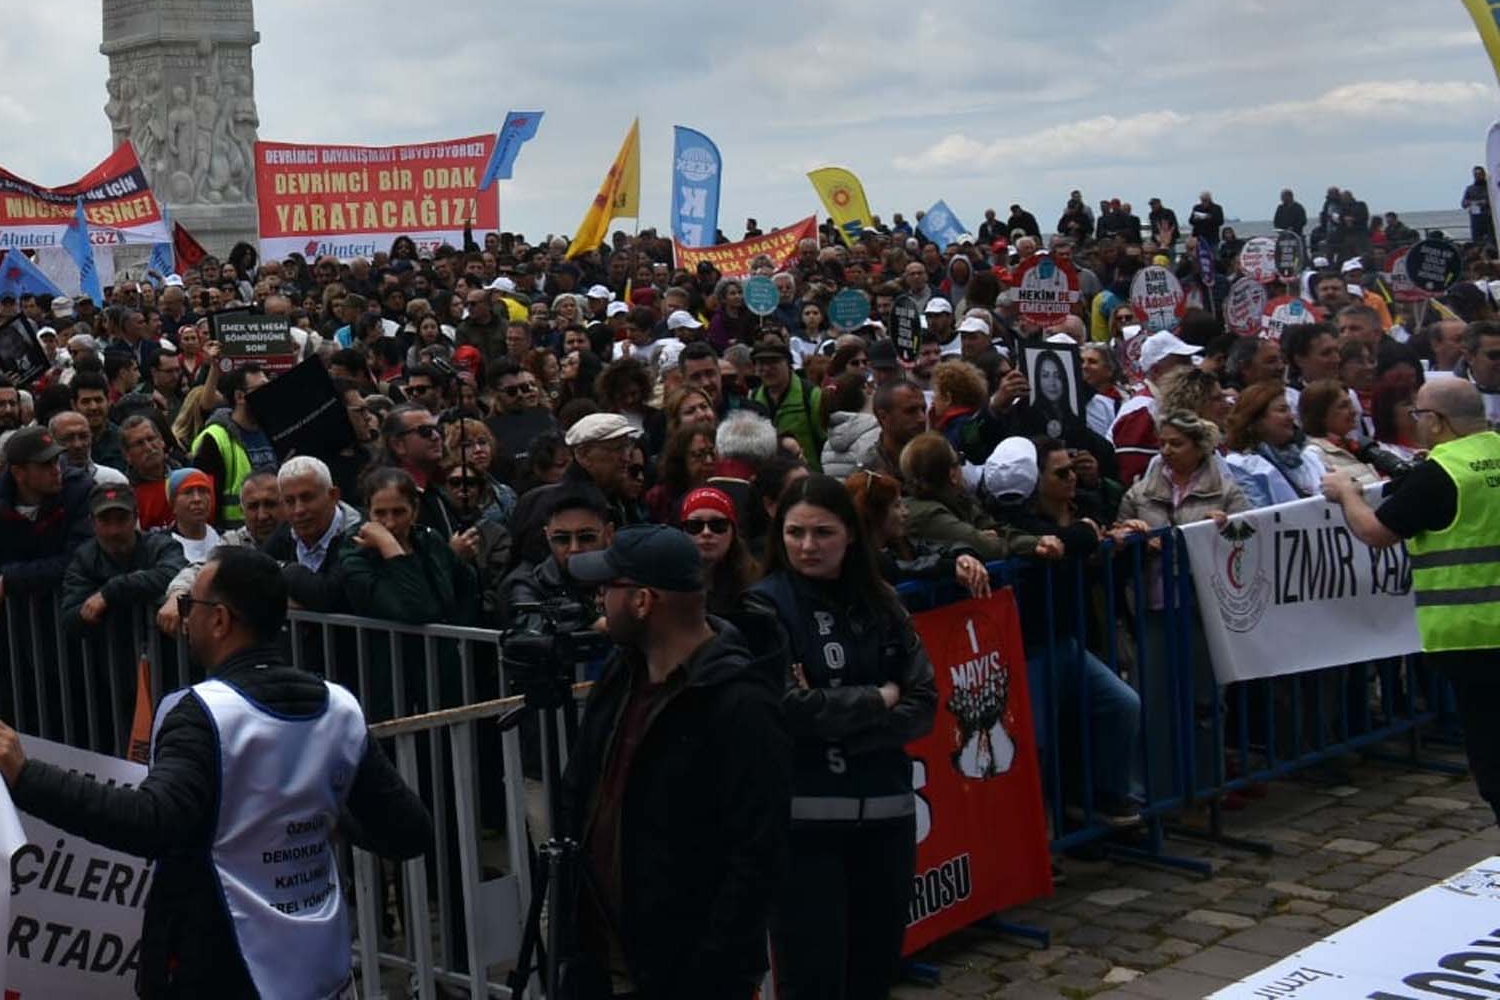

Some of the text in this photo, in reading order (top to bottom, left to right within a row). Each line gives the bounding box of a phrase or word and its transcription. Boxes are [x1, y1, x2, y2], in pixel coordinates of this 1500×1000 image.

[275, 167, 477, 195] DEVRİMCİ BİR ODAK
[275, 194, 477, 232] YARATACAĞIZ!
[1018, 289, 1056, 301] HEKİM
[1274, 508, 1357, 605] İZMİR
[965, 618, 979, 654] 1
[950, 650, 1000, 691] MAYIS
[10, 839, 153, 909] ÇİLERİ
